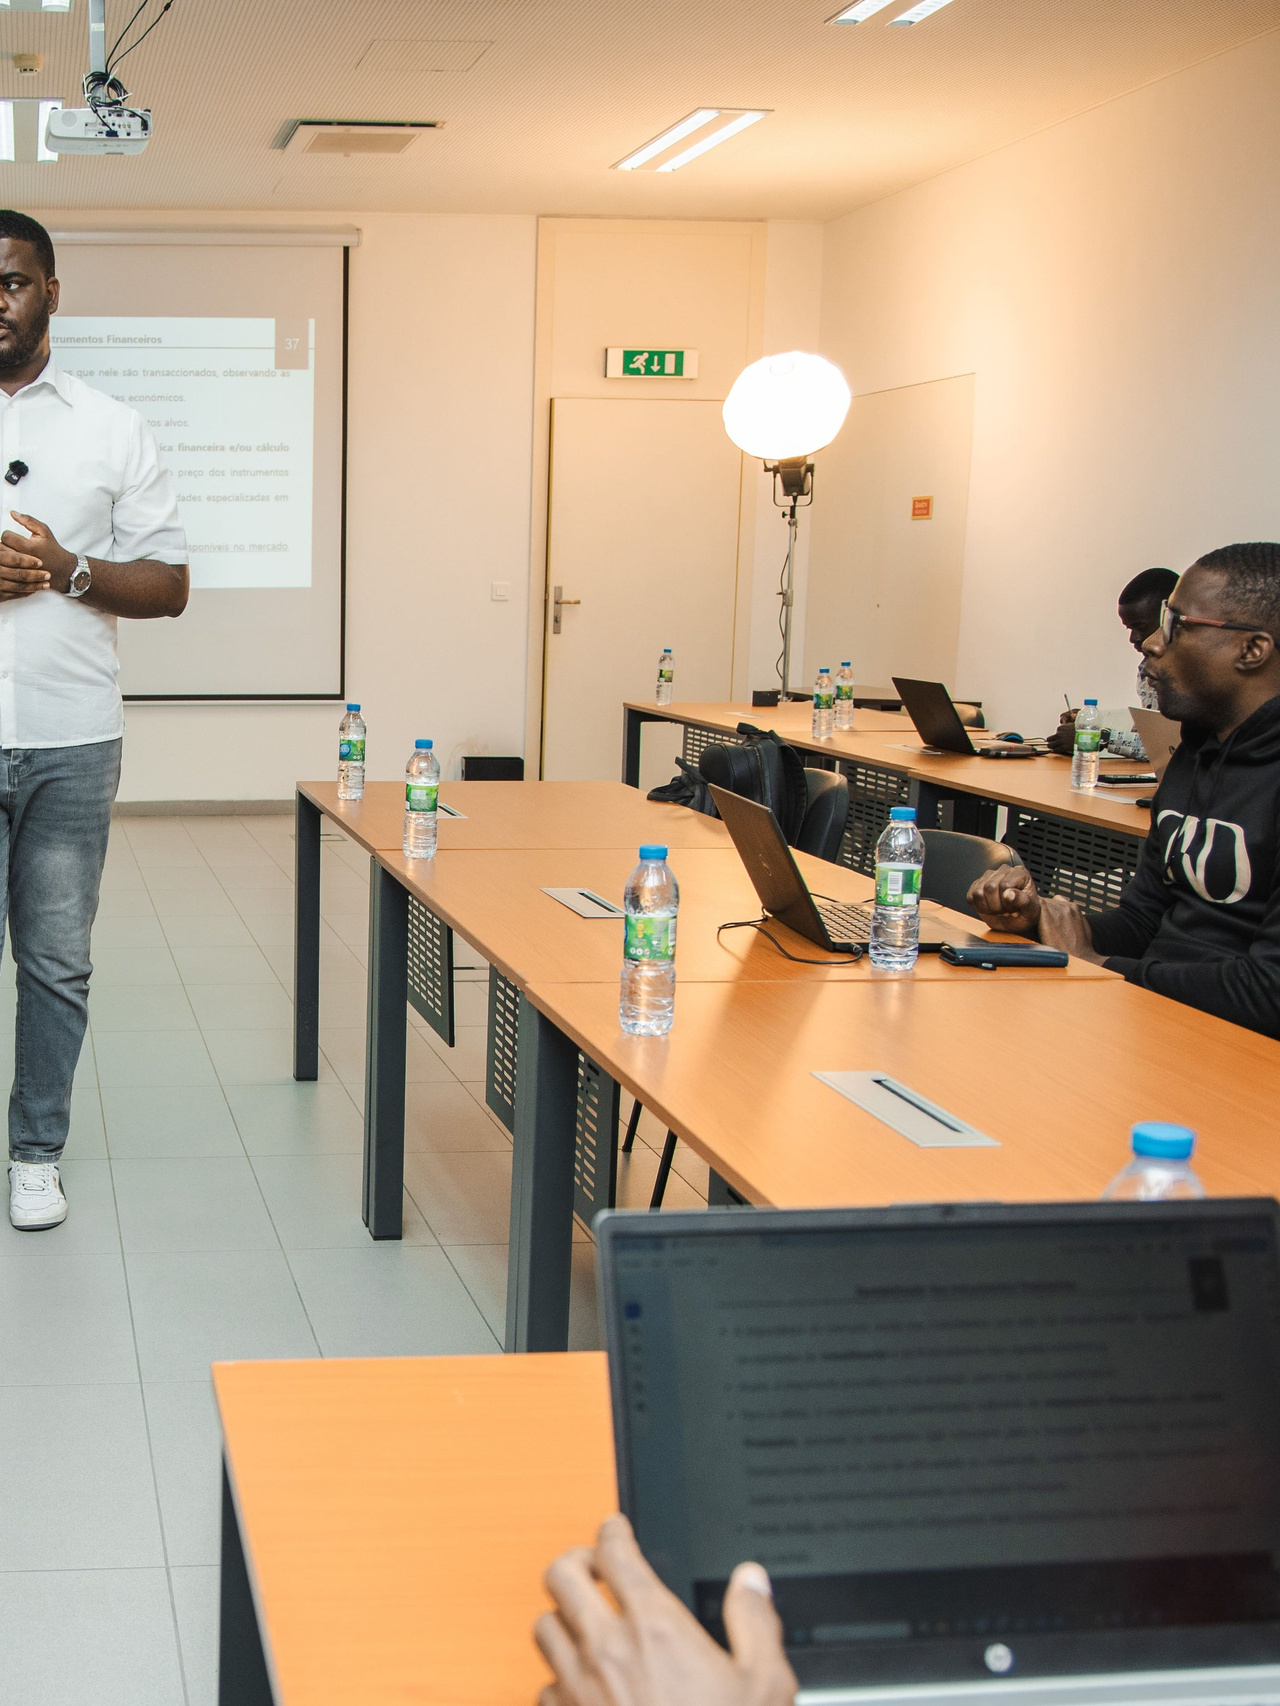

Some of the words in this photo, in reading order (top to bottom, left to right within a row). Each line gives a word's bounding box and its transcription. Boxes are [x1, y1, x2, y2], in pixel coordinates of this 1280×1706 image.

[106, 334, 163, 344] Financeiros
[285, 337, 300, 350] 37
[76, 369, 95, 379] que
[98, 367, 117, 377] nele
[122, 367, 138, 377] são
[142, 367, 218, 379] transaccionados,
[222, 367, 277, 378] observando
[280, 370, 290, 378] as
[128, 393, 186, 402] económicos.
[164, 418, 191, 428] alvos.
[177, 442, 225, 452] financeira
[229, 443, 252, 453] e/ou
[256, 442, 290, 452] cálculo
[177, 468, 204, 479] preço
[208, 467, 226, 477] dos
[230, 468, 290, 477] instrumentos
[206, 493, 270, 504] especializadas
[274, 494, 289, 502] em
[233, 543, 245, 551] no
[249, 541, 288, 552] mercado
